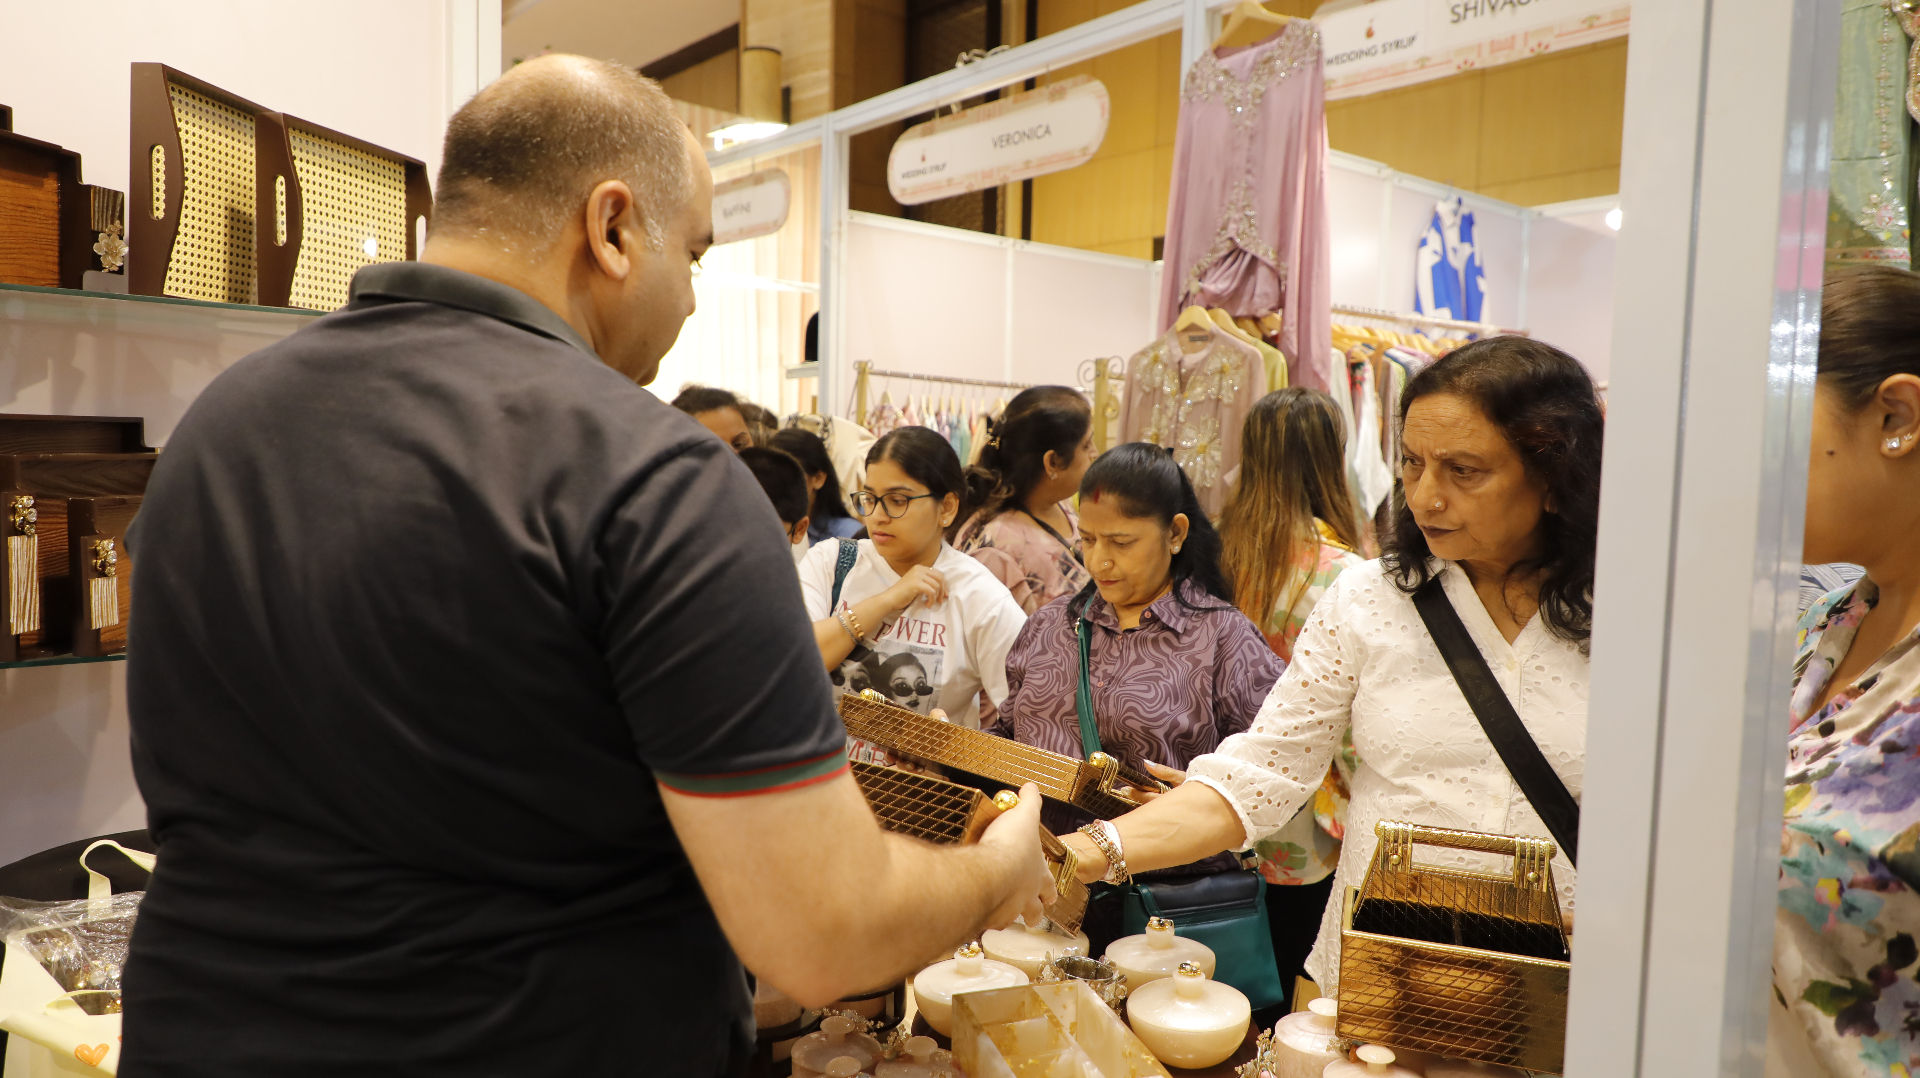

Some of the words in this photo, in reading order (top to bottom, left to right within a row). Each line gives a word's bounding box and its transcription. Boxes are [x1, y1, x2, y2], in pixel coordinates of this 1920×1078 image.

[1450, 0, 1539, 24] SHIVA
[1326, 45, 1379, 67] WEDDING
[1381, 34, 1417, 54] SYRUP
[991, 123, 1052, 150] VERONICA
